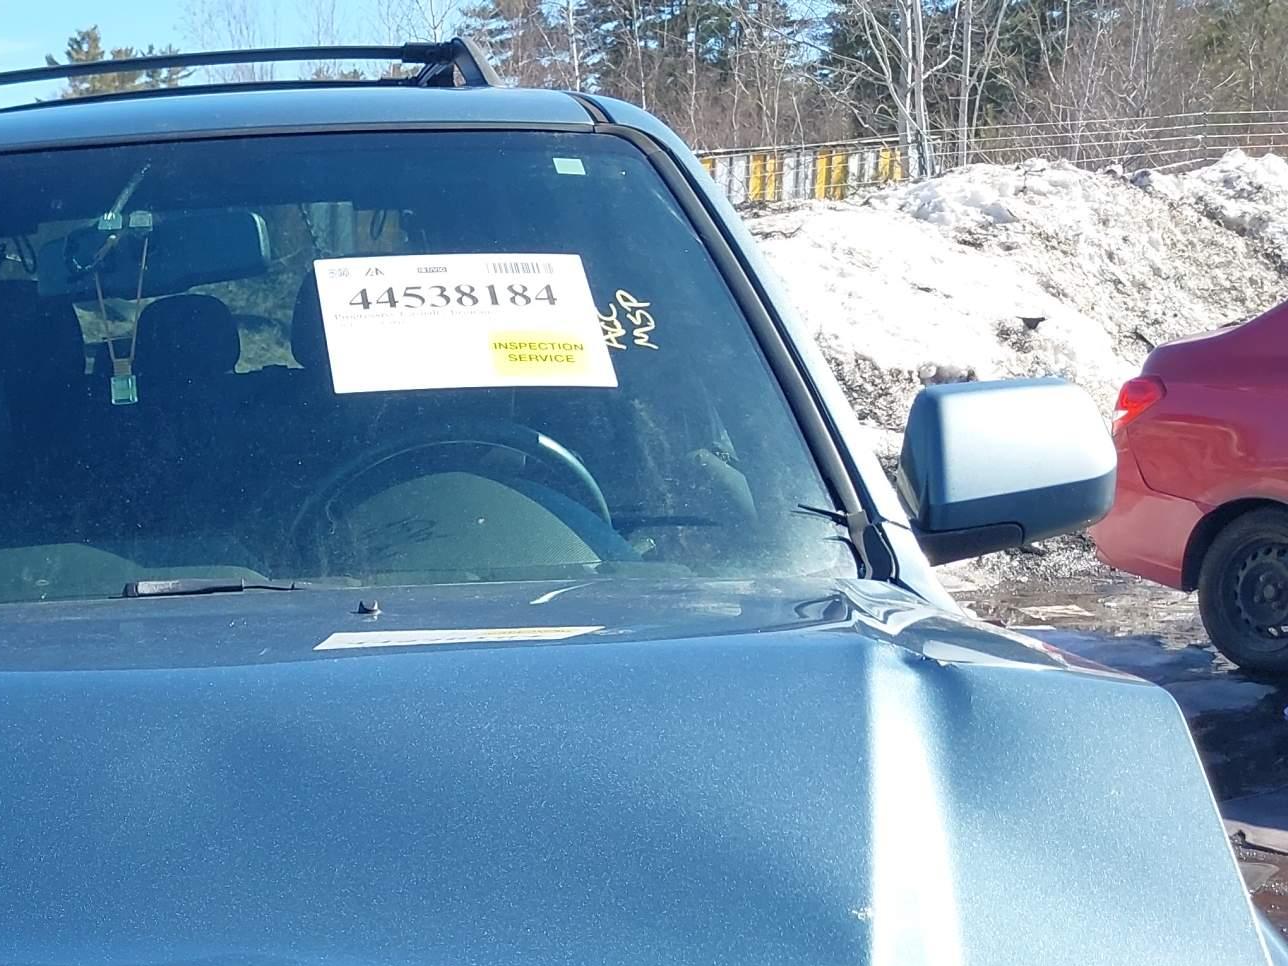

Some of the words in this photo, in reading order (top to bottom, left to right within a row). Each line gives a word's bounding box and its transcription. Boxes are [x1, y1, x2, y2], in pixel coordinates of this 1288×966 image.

[349, 284, 557, 310] 44538184
[615, 289, 659, 349] MSP
[492, 342, 584, 351] INSPECTION
[508, 353, 577, 363] SERVICE
